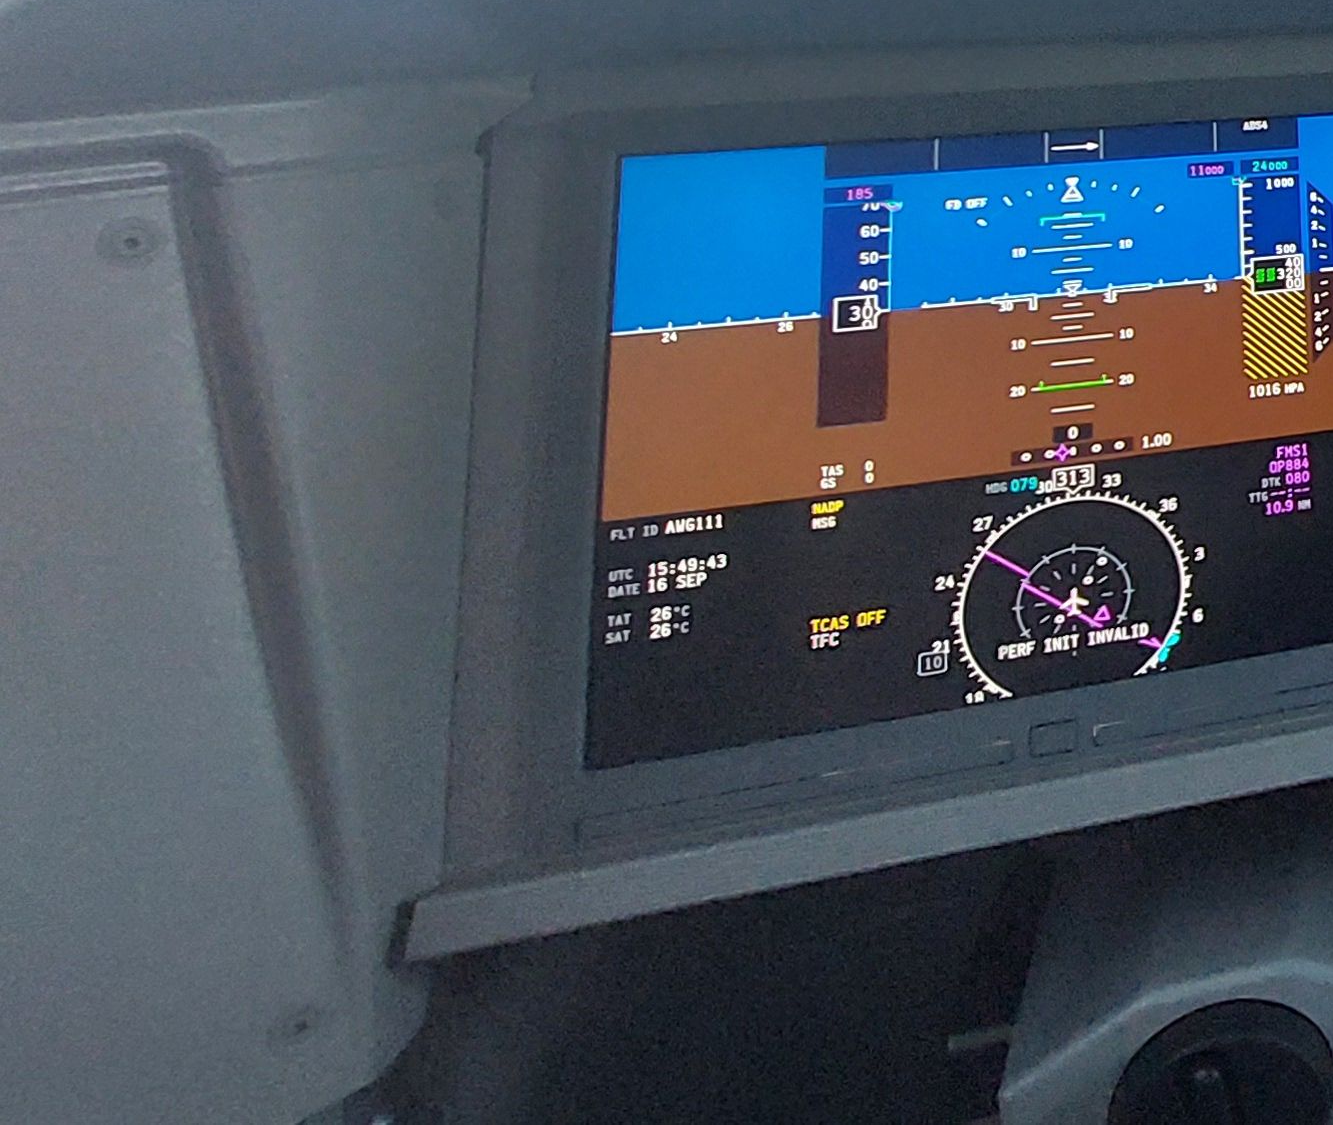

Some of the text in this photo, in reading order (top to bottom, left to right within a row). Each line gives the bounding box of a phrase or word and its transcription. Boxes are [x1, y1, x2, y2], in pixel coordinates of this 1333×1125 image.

[1190, 164, 1224, 177] 11000
[1252, 160, 1287, 172] 24000
[1265, 177, 1295, 189] 1000
[846, 188, 873, 200] 185
[860, 225, 879, 238] 60
[859, 251, 879, 265] 50
[859, 278, 878, 291] 40
[1142, 433, 1172, 447] 1.00
[1277, 444, 1308, 458] FMS1
[1261, 471, 1310, 489] DTK 080
[610, 515, 724, 540] FLT ID AWG111
[609, 554, 728, 582] UTC 15:49:43
[607, 573, 707, 597] DATE 16 SEP
[607, 604, 690, 627] TAT 26°C
[810, 610, 886, 632] TCAS OFF
[604, 620, 690, 644] SAT 26°C
[810, 633, 840, 648] TFC
[998, 623, 1149, 660] PERF INIT INVALID
